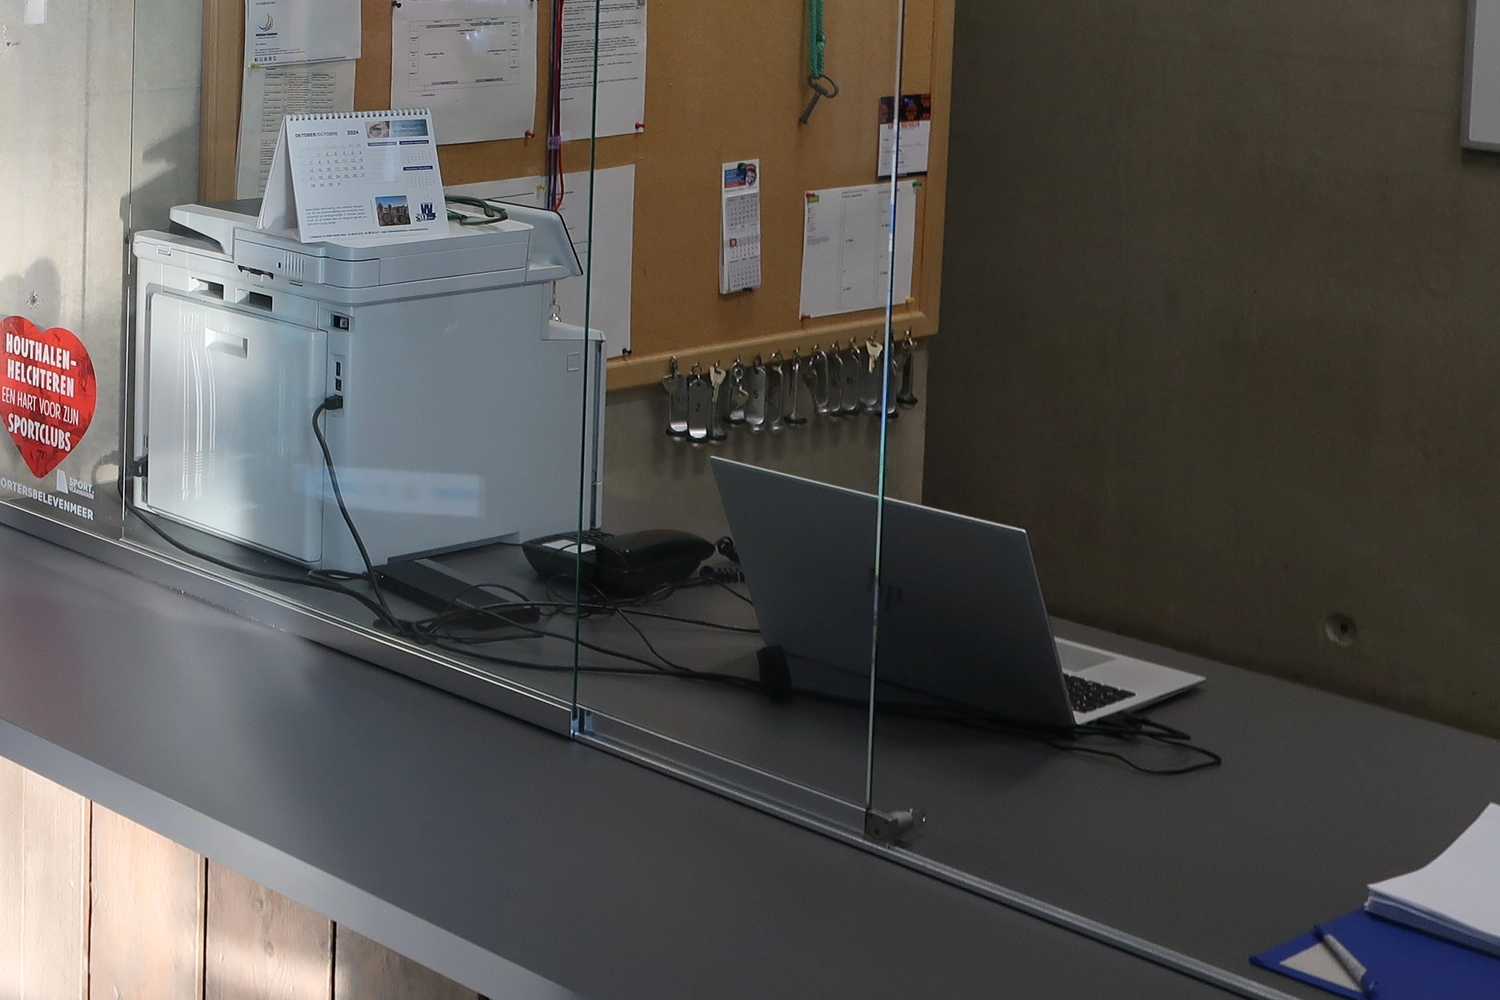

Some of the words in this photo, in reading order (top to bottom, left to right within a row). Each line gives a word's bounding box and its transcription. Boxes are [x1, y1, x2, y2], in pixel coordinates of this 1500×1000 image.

[6, 333, 76, 370] HOUTHALEN-
[8, 359, 74, 398] HELCHTEREN
[2, 386, 15, 405] EEN
[18, 391, 36, 411] HART
[39, 398, 61, 420] VOOR
[63, 406, 78, 425] ZIJN
[8, 413, 70, 452] SPORTCLUBS
